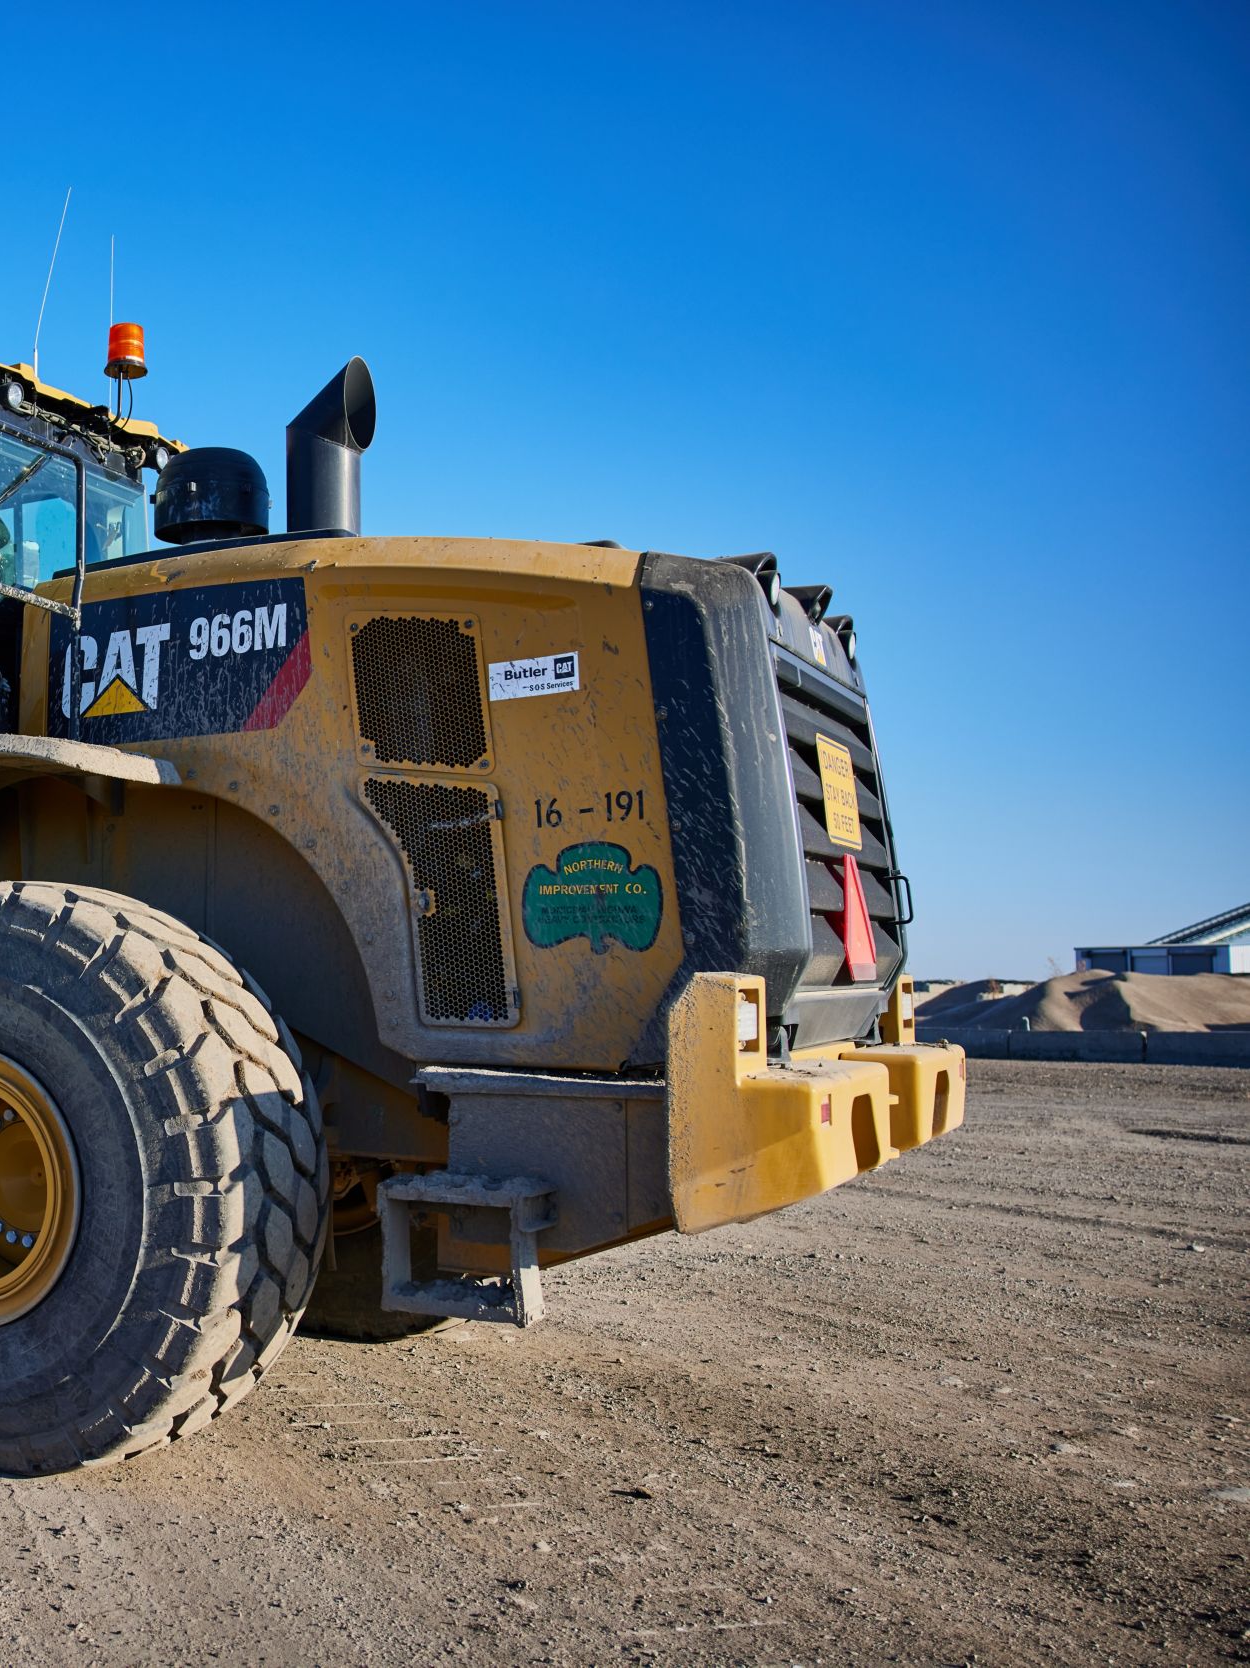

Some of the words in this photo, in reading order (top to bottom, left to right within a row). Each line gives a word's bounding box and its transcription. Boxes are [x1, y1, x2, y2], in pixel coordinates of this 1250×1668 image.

[189, 603, 288, 660] 966M
[62, 623, 171, 719] CAT
[504, 667, 547, 681] Butler
[555, 661, 573, 674] CAT
[546, 680, 574, 690] Services
[825, 783, 840, 804] STAY
[840, 788, 856, 810] BACK
[535, 798, 562, 828] 16
[605, 789, 644, 822] 191
[833, 812, 841, 831] 50
[841, 814, 854, 834] FEET
[563, 859, 624, 876] NORTHERN
[625, 882, 647, 895] CO.
